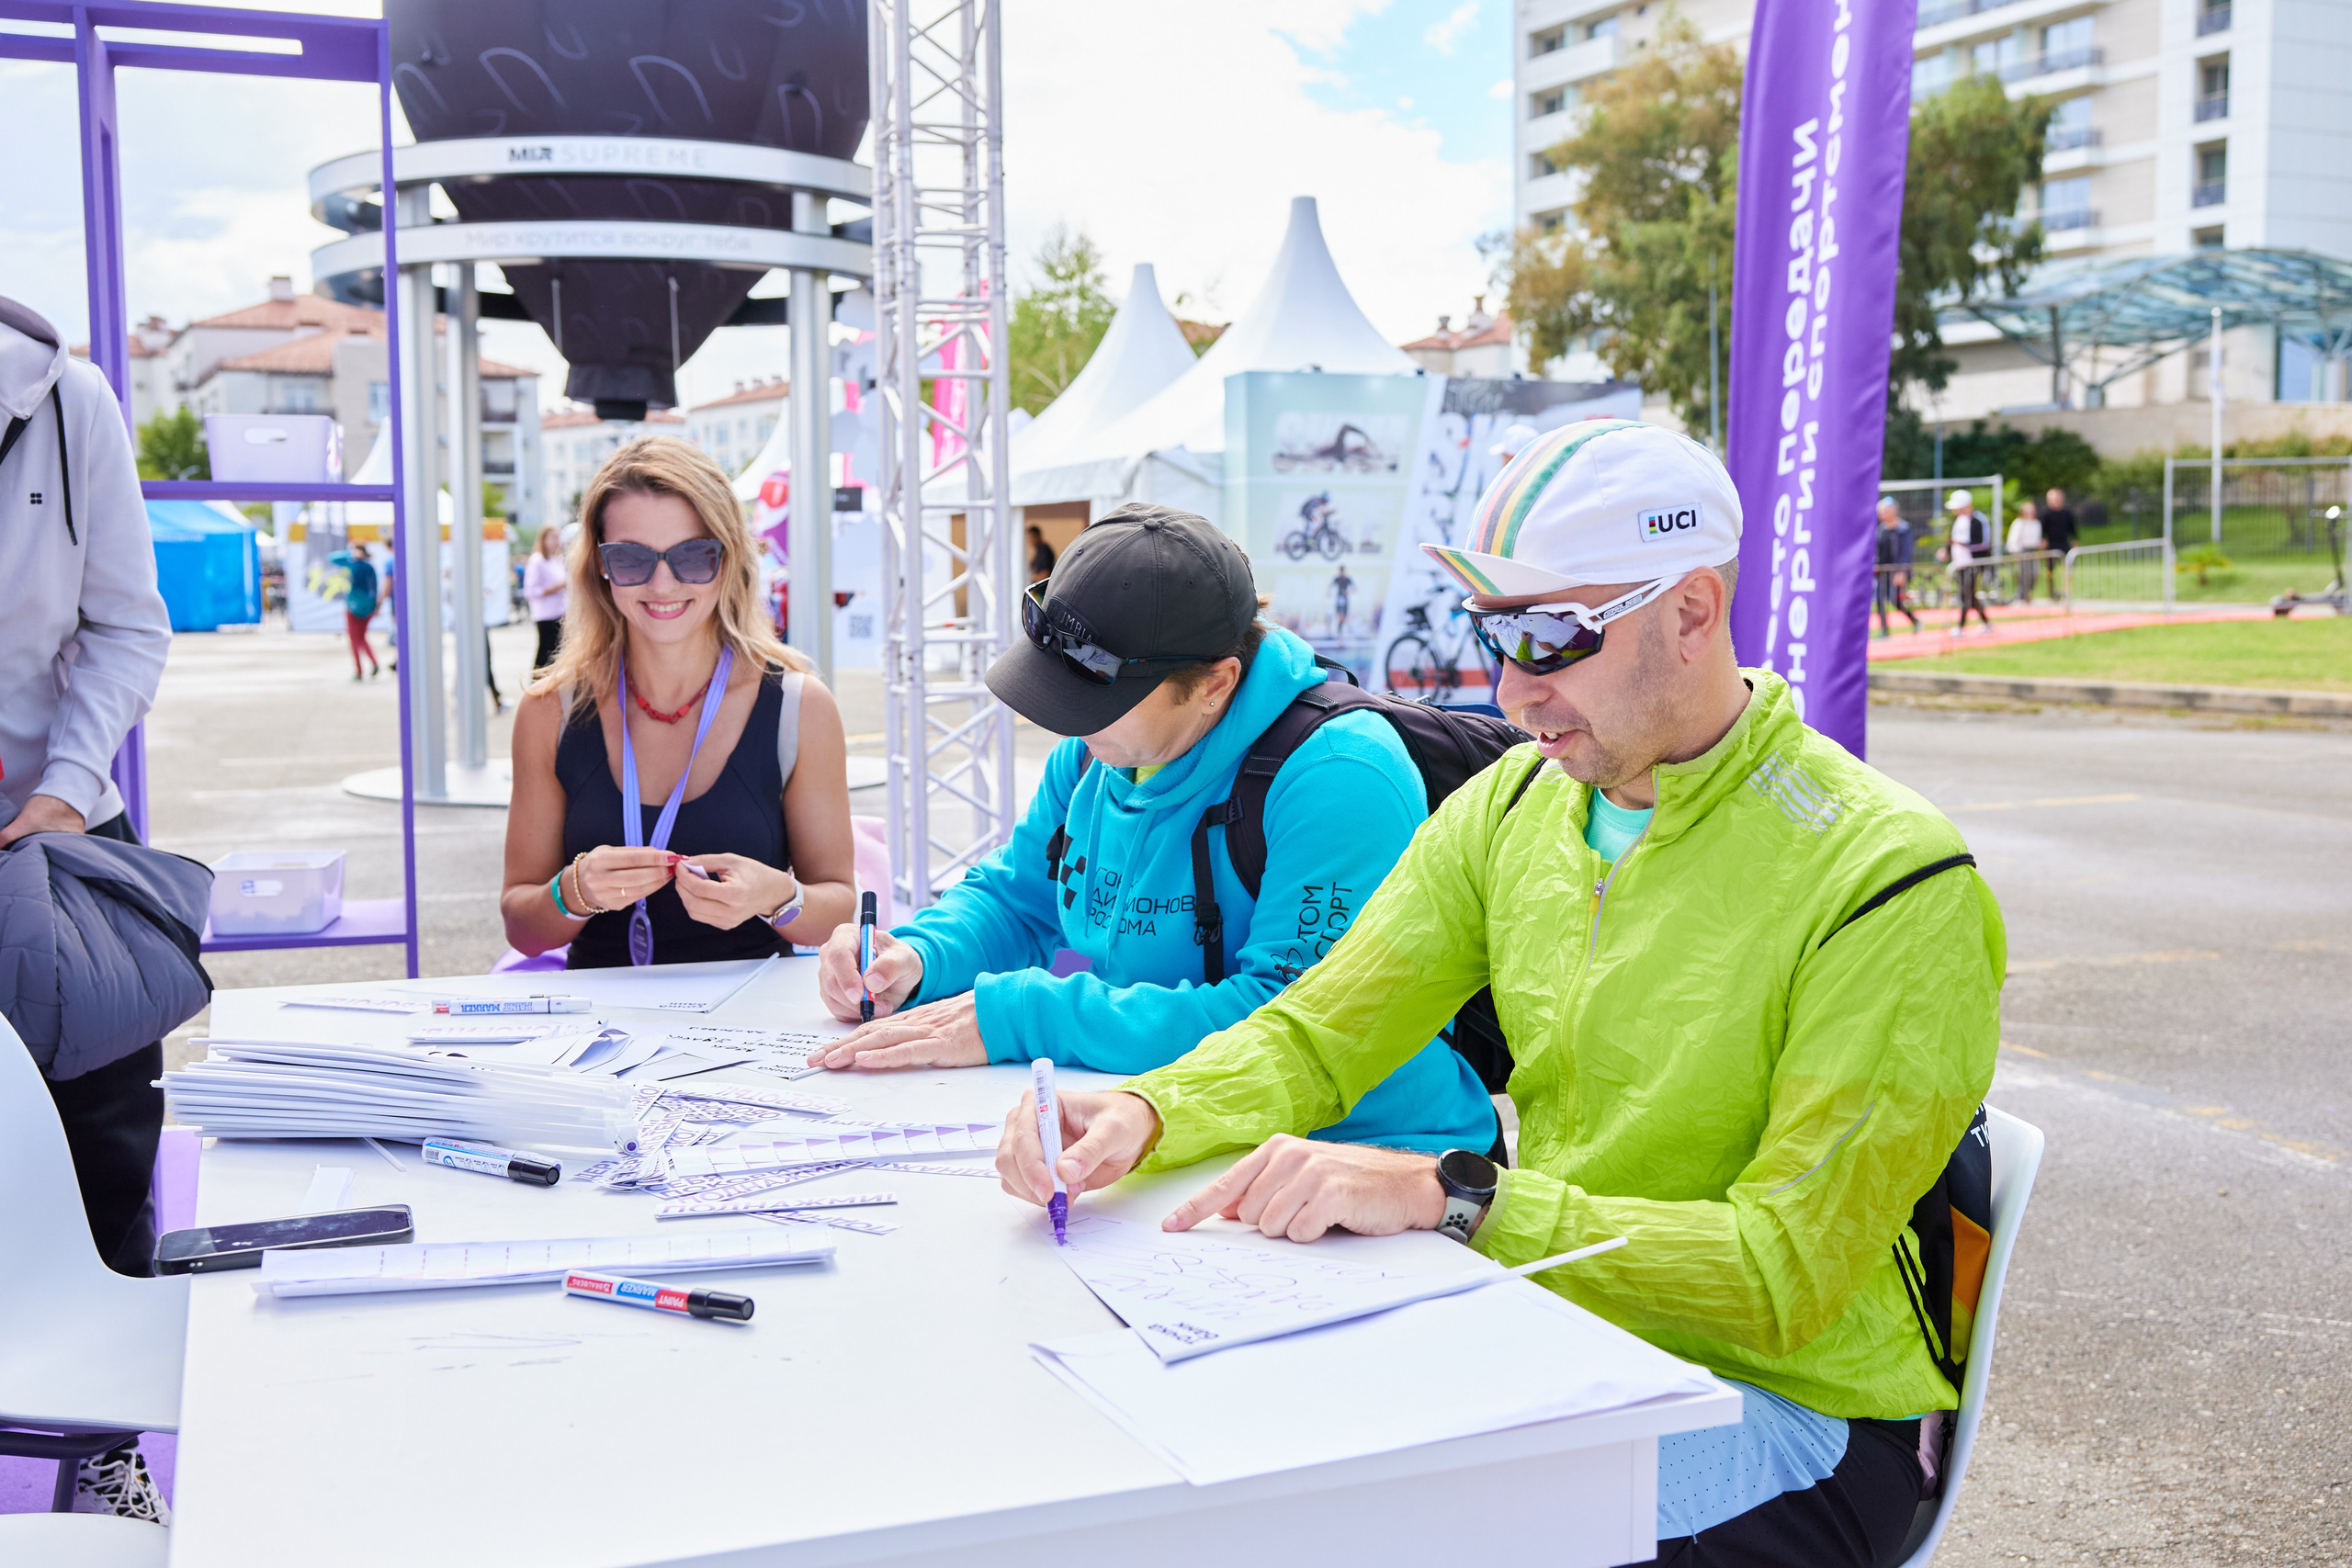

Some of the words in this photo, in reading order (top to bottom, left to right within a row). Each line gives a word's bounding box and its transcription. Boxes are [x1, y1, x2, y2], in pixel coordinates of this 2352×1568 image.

[1776, 117, 1819, 477] передачи
[1657, 509, 1697, 533] UCI
[460, 1003, 501, 1012] MARKER
[662, 1192, 894, 1213] ПОДНАЖМИ!
[571, 1278, 605, 1292] BRAUBERG
[620, 1282, 659, 1297] MARKER
[657, 1294, 685, 1308] PAINT
